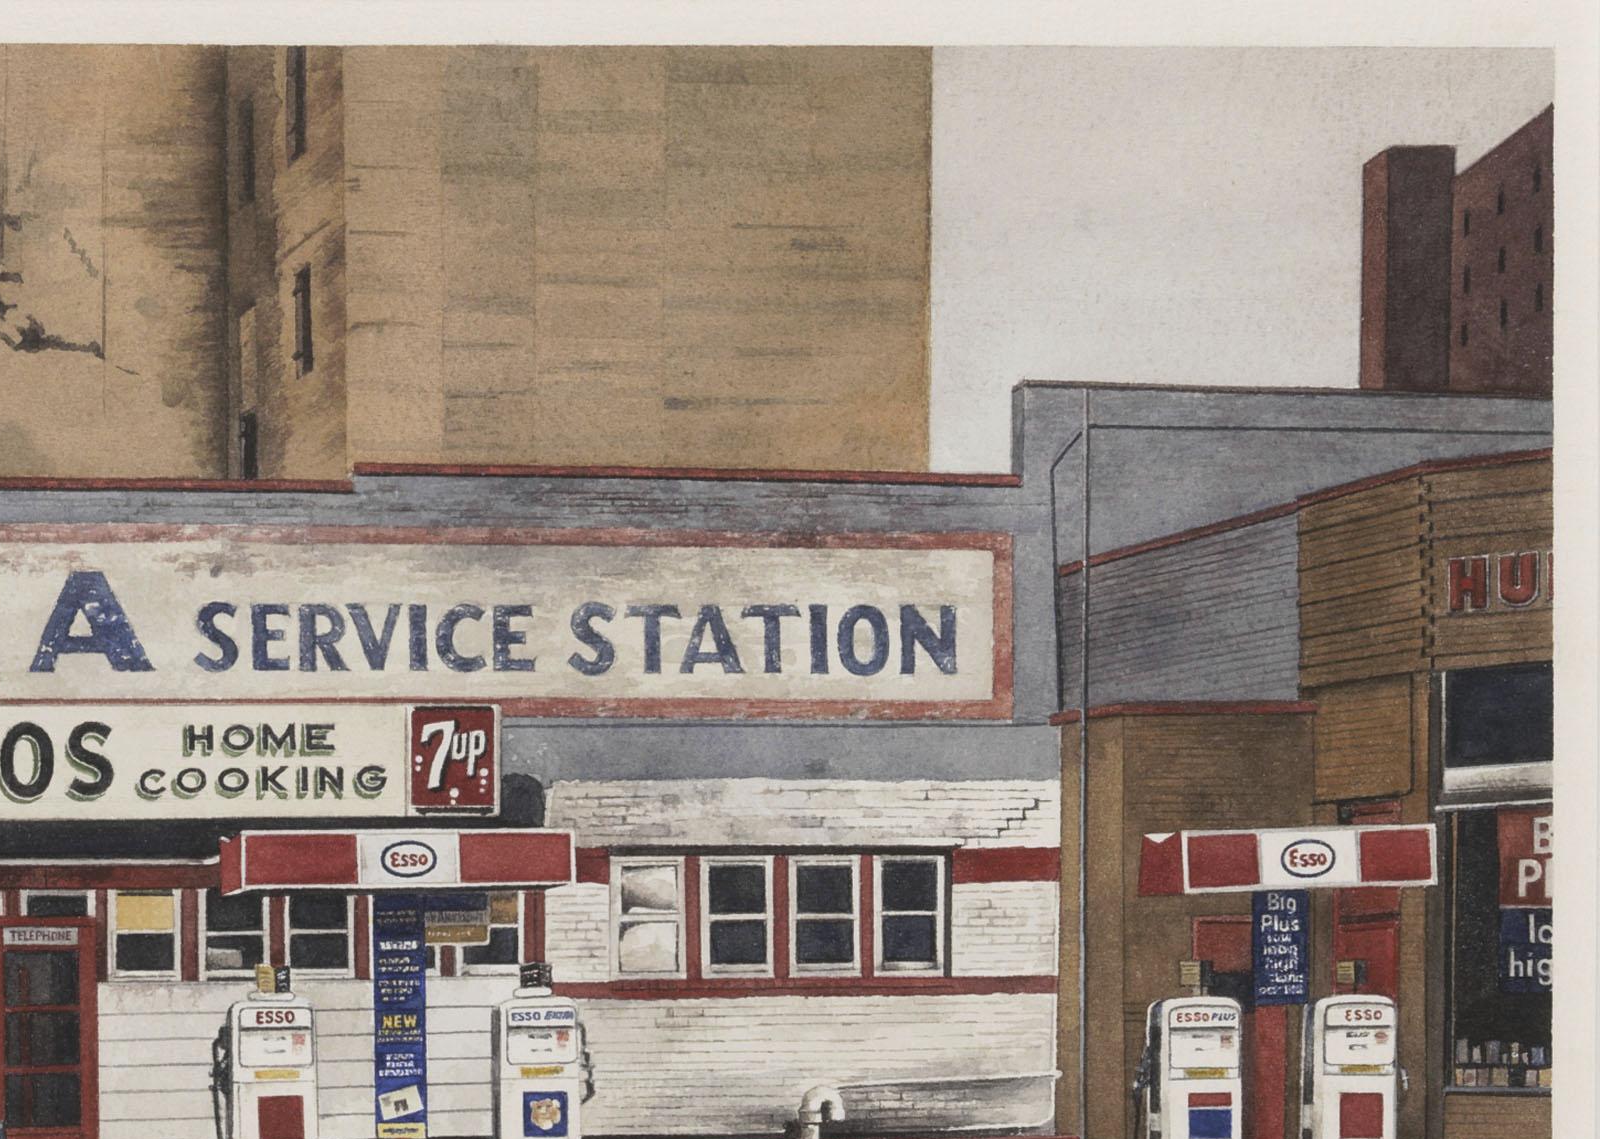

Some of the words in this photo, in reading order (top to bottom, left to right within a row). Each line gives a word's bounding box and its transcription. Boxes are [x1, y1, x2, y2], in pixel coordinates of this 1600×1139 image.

[1447, 551, 1554, 613] HU
[193, 601, 537, 673] SERVICE
[568, 602, 958, 677] STATION
[182, 722, 336, 758] HOME
[135, 764, 388, 801] COOKING
[1261, 914, 1300, 932] Plus
[9, 929, 72, 942] TELEPHONE
[255, 1010, 296, 1025] ESSO
[383, 1014, 418, 1029] NEW
[511, 1011, 541, 1022] ESSO
[1176, 1011, 1210, 1023] ESSO
[1211, 1011, 1238, 1022] PLUS
[1344, 1009, 1383, 1021] ESSO
